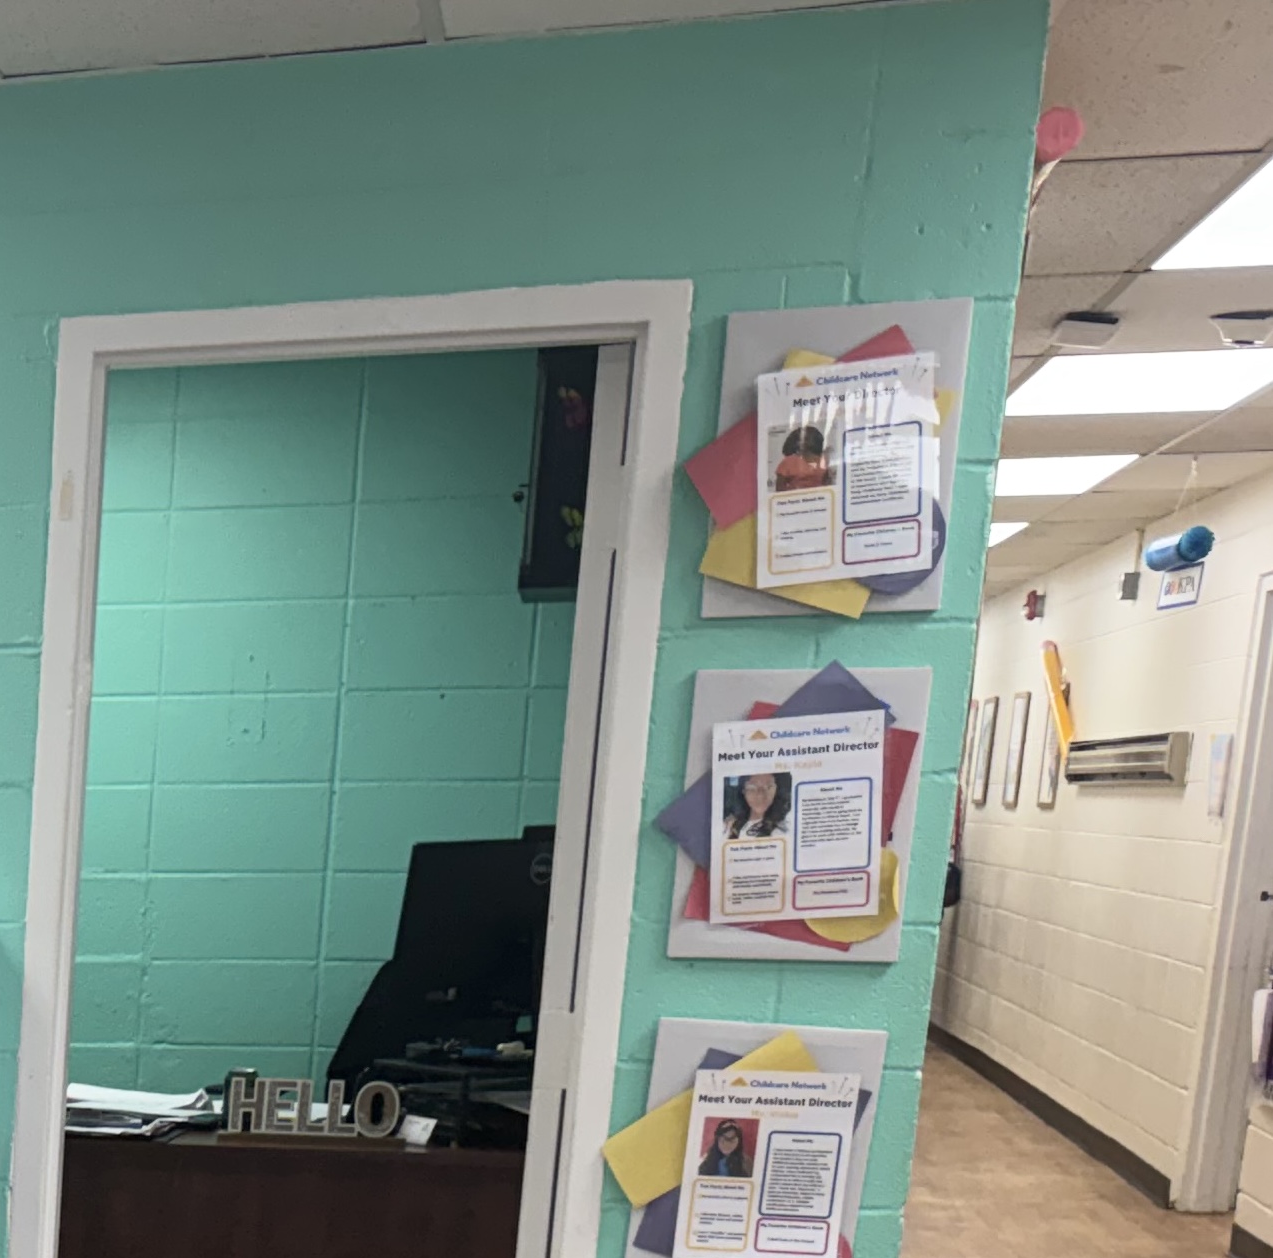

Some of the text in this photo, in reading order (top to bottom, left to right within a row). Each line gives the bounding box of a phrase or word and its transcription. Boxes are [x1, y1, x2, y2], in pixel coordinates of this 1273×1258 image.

[770, 726, 850, 739] Childcare Network
[718, 740, 879, 761] Meet Your Assistant Director
[227, 1076, 401, 1139] HELLO
[698, 1094, 853, 1108] Meet Your Assistant Director
